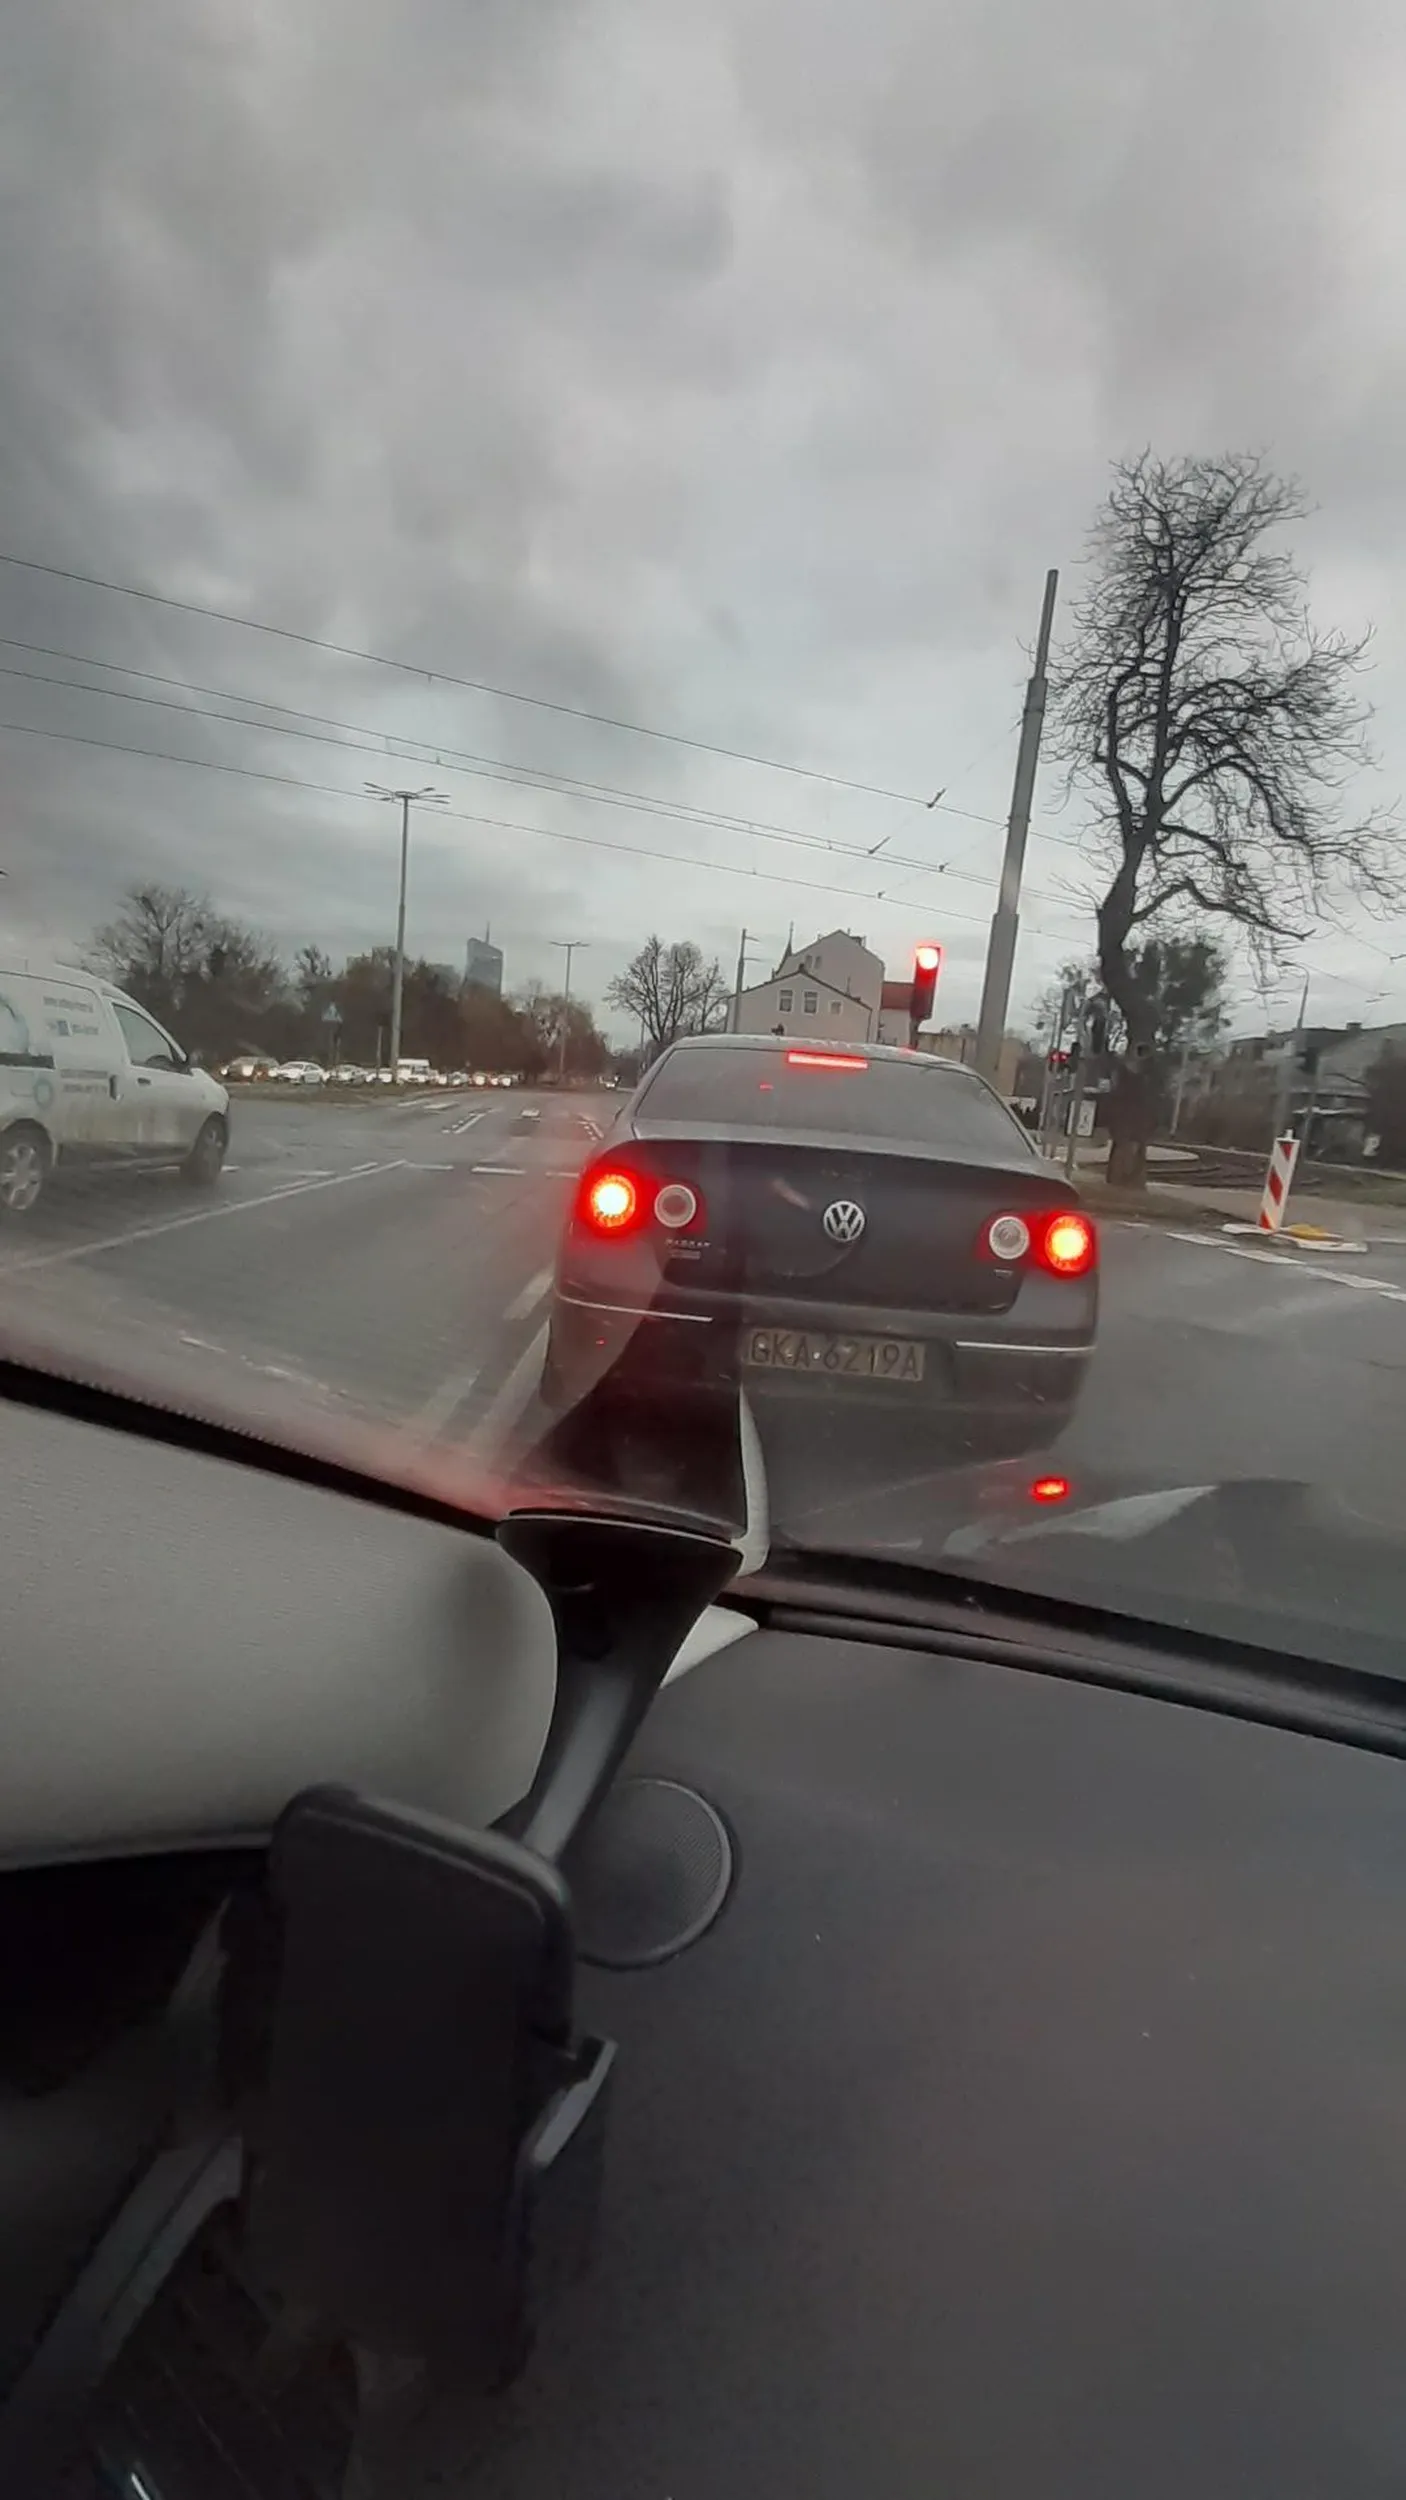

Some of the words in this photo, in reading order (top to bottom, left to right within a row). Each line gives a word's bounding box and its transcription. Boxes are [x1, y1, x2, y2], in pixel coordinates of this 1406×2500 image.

[824, 1201, 864, 1241] VW
[752, 1332, 810, 1368] GKA
[824, 1338, 918, 1379] 6219A
